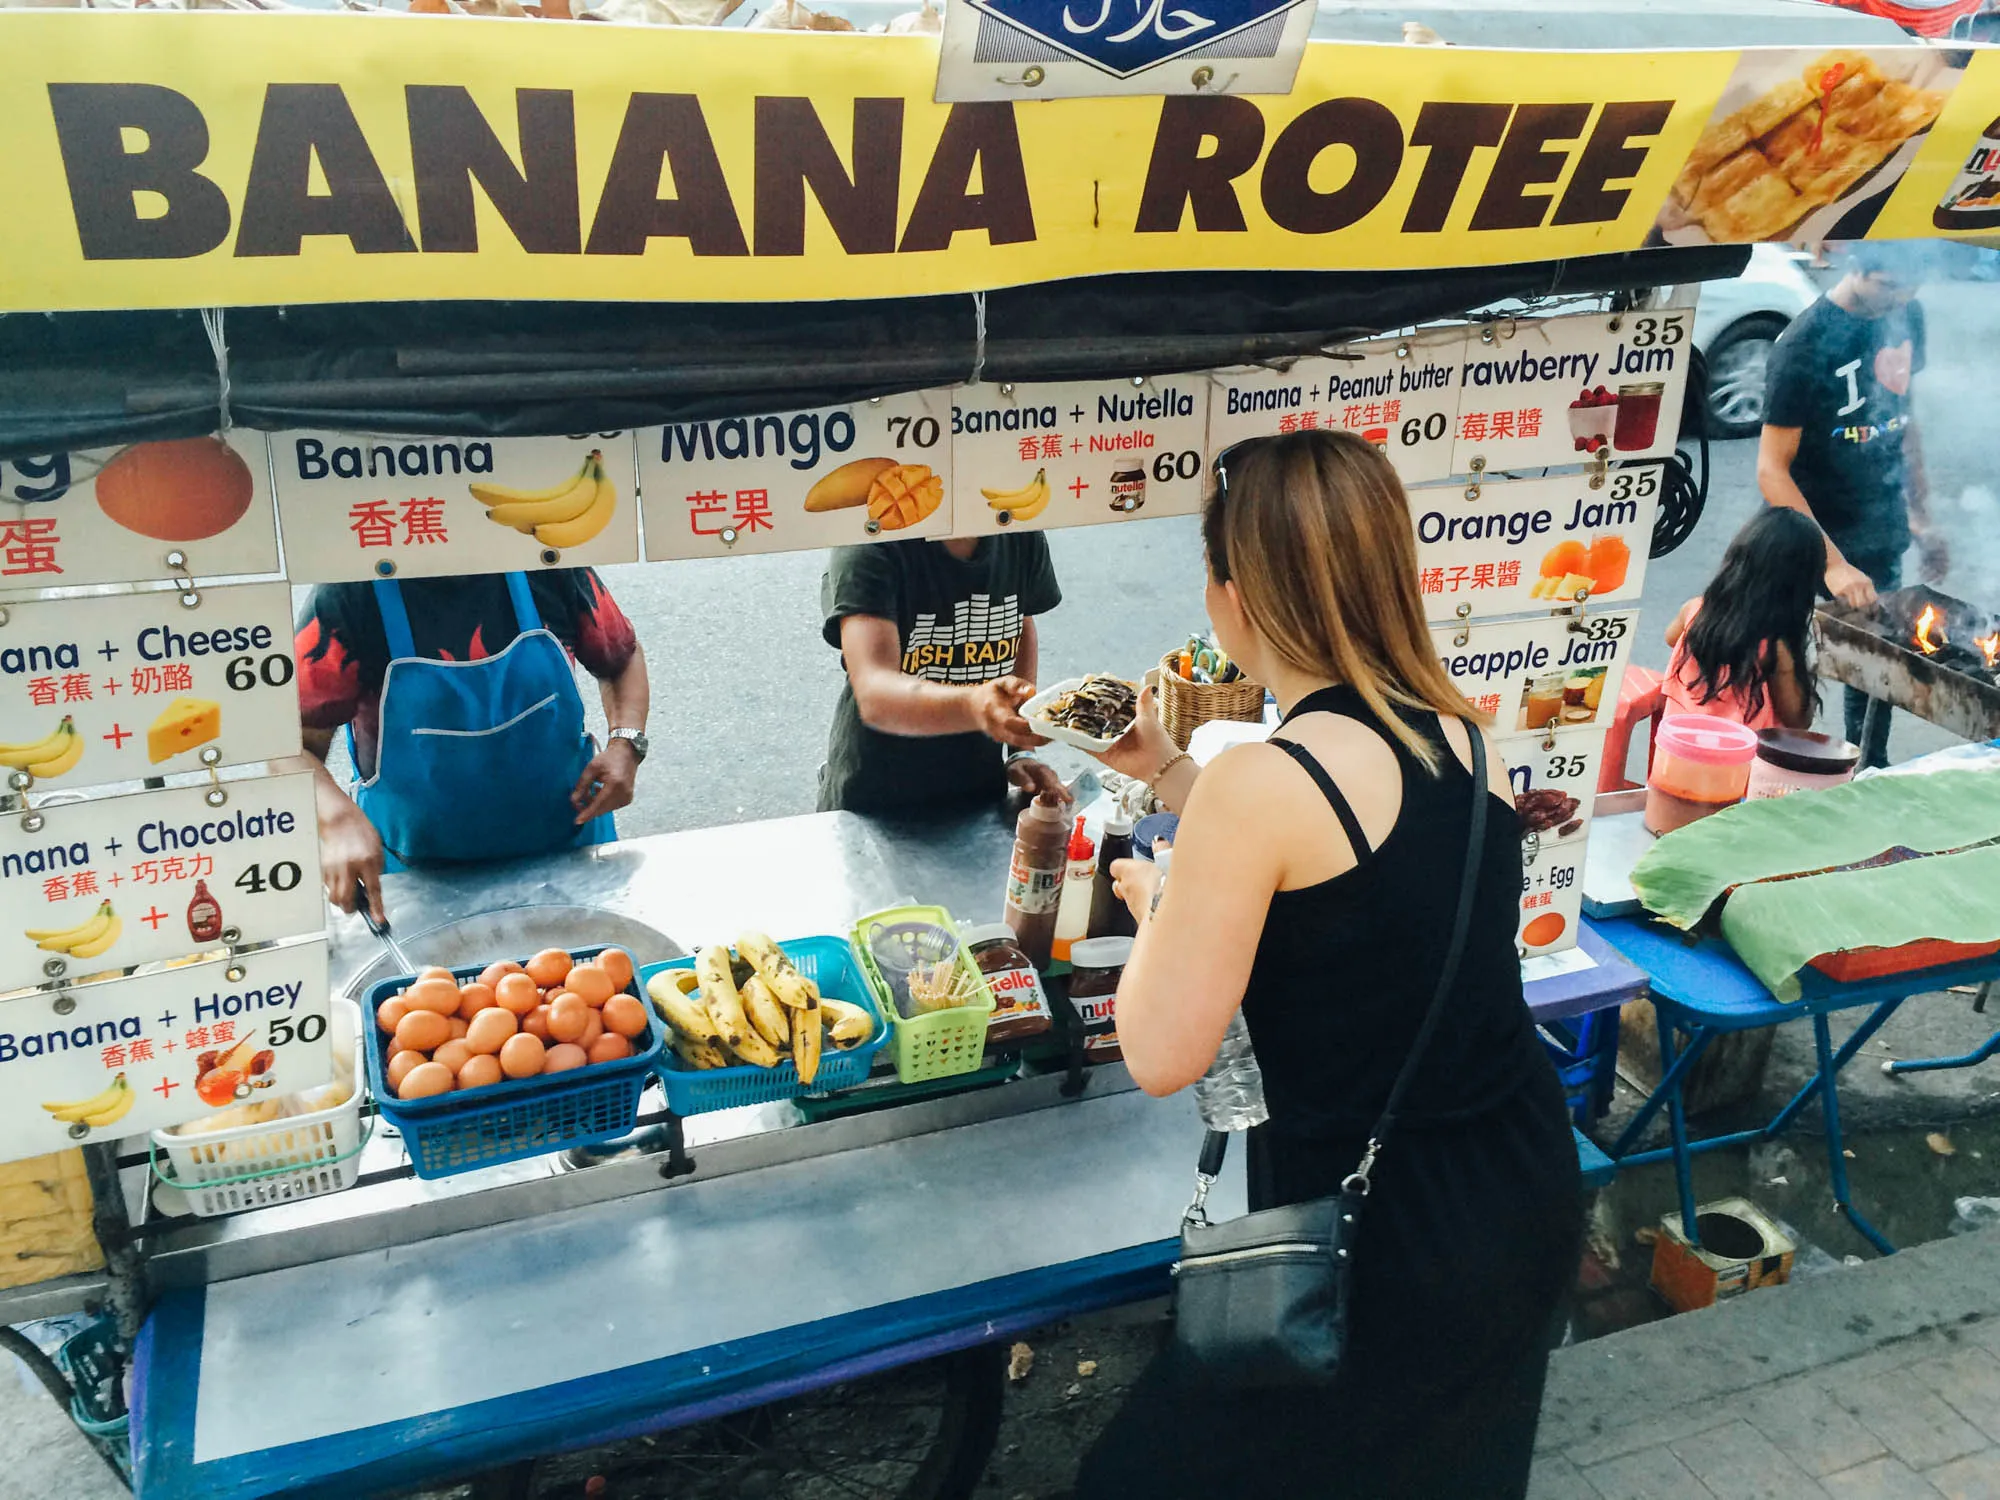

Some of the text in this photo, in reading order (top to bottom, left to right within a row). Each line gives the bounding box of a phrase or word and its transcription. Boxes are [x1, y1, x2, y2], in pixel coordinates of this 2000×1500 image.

[47, 83, 1676, 260] BANANA ROTEE
[1633, 314, 1685, 347] 35
[1608, 342, 1675, 376] Jam
[1226, 384, 1301, 415] Banana
[1328, 368, 1393, 402] Peanut
[1400, 362, 1454, 392] butter
[951, 404, 1057, 434] Banana
[1097, 388, 1193, 423] Nutella
[1456, 407, 1543, 442] 莓果醬
[661, 411, 856, 470] Mango
[887, 416, 940, 448] 70
[1018, 433, 1063, 461] 香蕉
[1089, 430, 1155, 453] Nutella
[1401, 412, 1447, 446] 60
[296, 438, 494, 479] Banana
[1153, 450, 1201, 482] 60
[1610, 468, 1657, 501] 35
[349, 497, 449, 548] 香蕉
[686, 488, 774, 535] 芒果
[1418, 497, 1637, 545] Orange Jam
[137, 625, 272, 661] Cheese
[1587, 617, 1628, 642] 35
[964, 637, 1020, 665] RADI
[1557, 637, 1618, 666] Jam
[28, 674, 93, 706] 香蕉
[131, 663, 193, 696] 奶酪
[225, 653, 294, 691] 60
[1547, 754, 1588, 779] 35
[138, 809, 295, 854] Chocolate
[43, 870, 99, 902] 香蕉
[132, 853, 213, 886] 巧克力
[235, 861, 302, 895] 40
[1550, 866, 1574, 889] Egg
[987, 970, 1035, 992] tella
[0, 1014, 141, 1062] Banana
[194, 980, 302, 1024] Honey
[267, 1013, 328, 1047] 50
[101, 1039, 154, 1070] 香蕉
[185, 1021, 236, 1051] 蜂蜜
